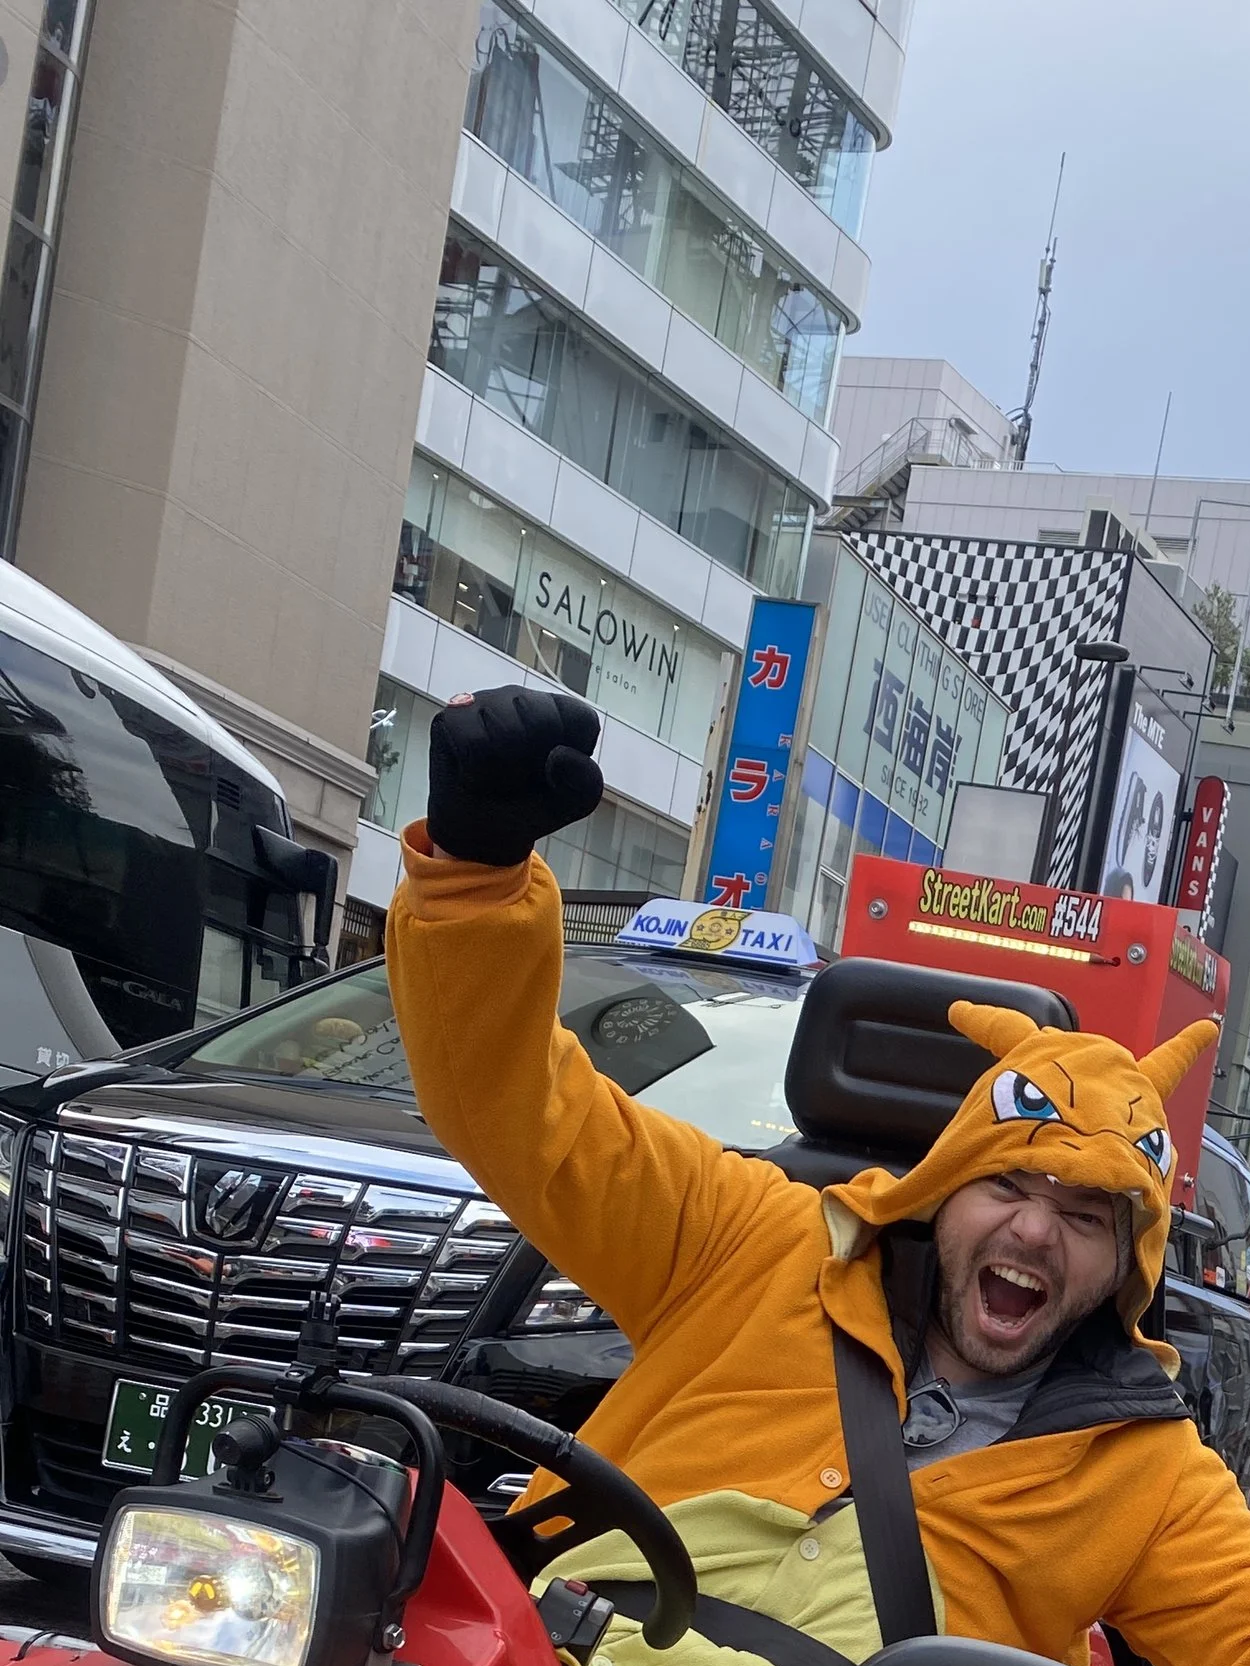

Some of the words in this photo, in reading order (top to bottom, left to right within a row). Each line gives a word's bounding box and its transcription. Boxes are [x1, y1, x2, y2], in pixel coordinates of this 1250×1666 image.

[535, 571, 678, 684] SALOWIN
[606, 671, 637, 695] salon
[1133, 701, 1148, 733] The
[1147, 716, 1166, 750] MTE
[751, 733, 793, 910] KARAO
[1188, 807, 1213, 896] VANS
[632, 914, 689, 938] KOJIN
[740, 929, 793, 952] TAXI
[919, 868, 1048, 933] StreetKart.com
[1049, 894, 1103, 942] #544
